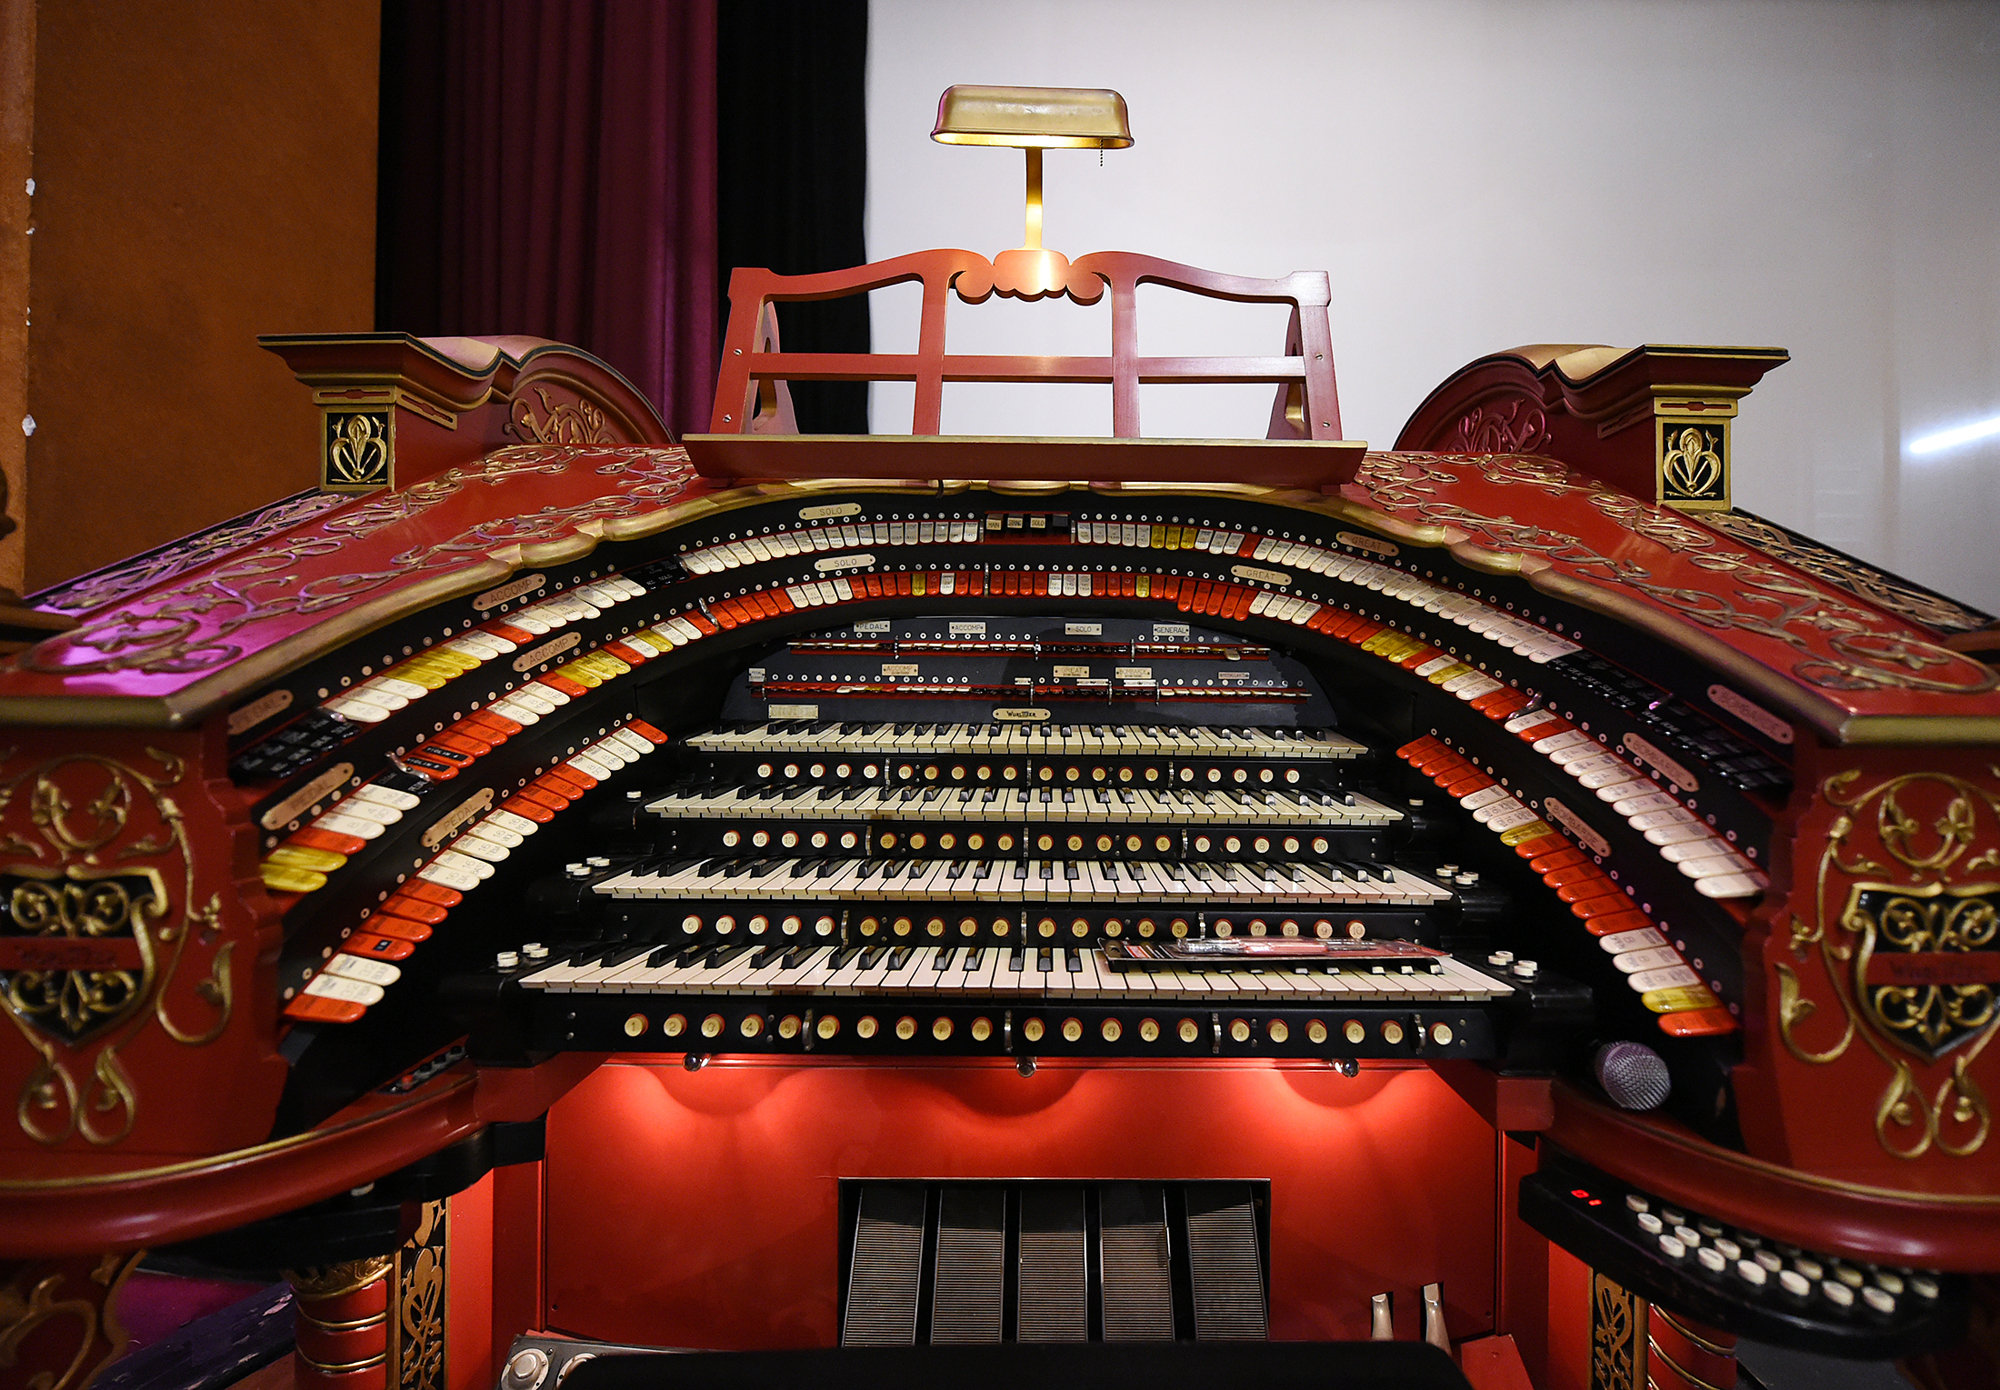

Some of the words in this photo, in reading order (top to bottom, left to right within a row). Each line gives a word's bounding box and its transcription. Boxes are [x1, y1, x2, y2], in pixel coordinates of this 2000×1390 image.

[820, 507, 842, 516] SOLO
[1352, 536, 1382, 550] GREAT
[834, 559, 857, 567] SOLO
[1246, 570, 1276, 580] GREAT
[490, 580, 532, 603] ACCOMP
[530, 638, 568, 665] ACCOMP
[444, 804, 478, 831] PEDAL
[1552, 804, 1599, 847] BOMBARDE
[726, 835, 734, 843] 11
[756, 835, 765, 843] 12
[785, 836, 794, 844] 13
[814, 836, 823, 844] 14
[844, 836, 853, 845] 15
[1072, 840, 1078, 848] 2
[1101, 840, 1107, 848] 3
[1130, 840, 1137, 848] 4
[478, 843, 490, 852] 16
[1317, 842, 1325, 850] 10
[687, 921, 694, 931] 6
[754, 922, 760, 931] 8
[787, 922, 793, 932] 9
[819, 922, 829, 932] 10
[899, 924, 905, 932] P
[930, 924, 941, 932] MF
[1076, 924, 1083, 934] 2
[1110, 923, 1117, 933] 3
[1142, 924, 1149, 933] 4
[1176, 924, 1183, 934] 5
[1220, 924, 1227, 935] 6
[1255, 924, 1262, 933] 7
[1287, 926, 1294, 936] 8
[1321, 926, 1328, 936] 9
[1352, 925, 1362, 936] 10
[669, 1022, 677, 1032] 2
[745, 1022, 753, 1032] 4
[784, 1024, 791, 1034] 5
[863, 1024, 869, 1033] P
[1069, 1027, 1076, 1036] 2
[1108, 1027, 1115, 1036] 3
[1145, 1027, 1153, 1036] 4
[1184, 1027, 1192, 1037] 5
[1237, 1027, 1244, 1037] 6
[1275, 1026, 1281, 1037] 7
[1353, 1026, 1359, 1038] 9
[1313, 1027, 1321, 1038] 8
[1389, 1027, 1399, 1038] 10
